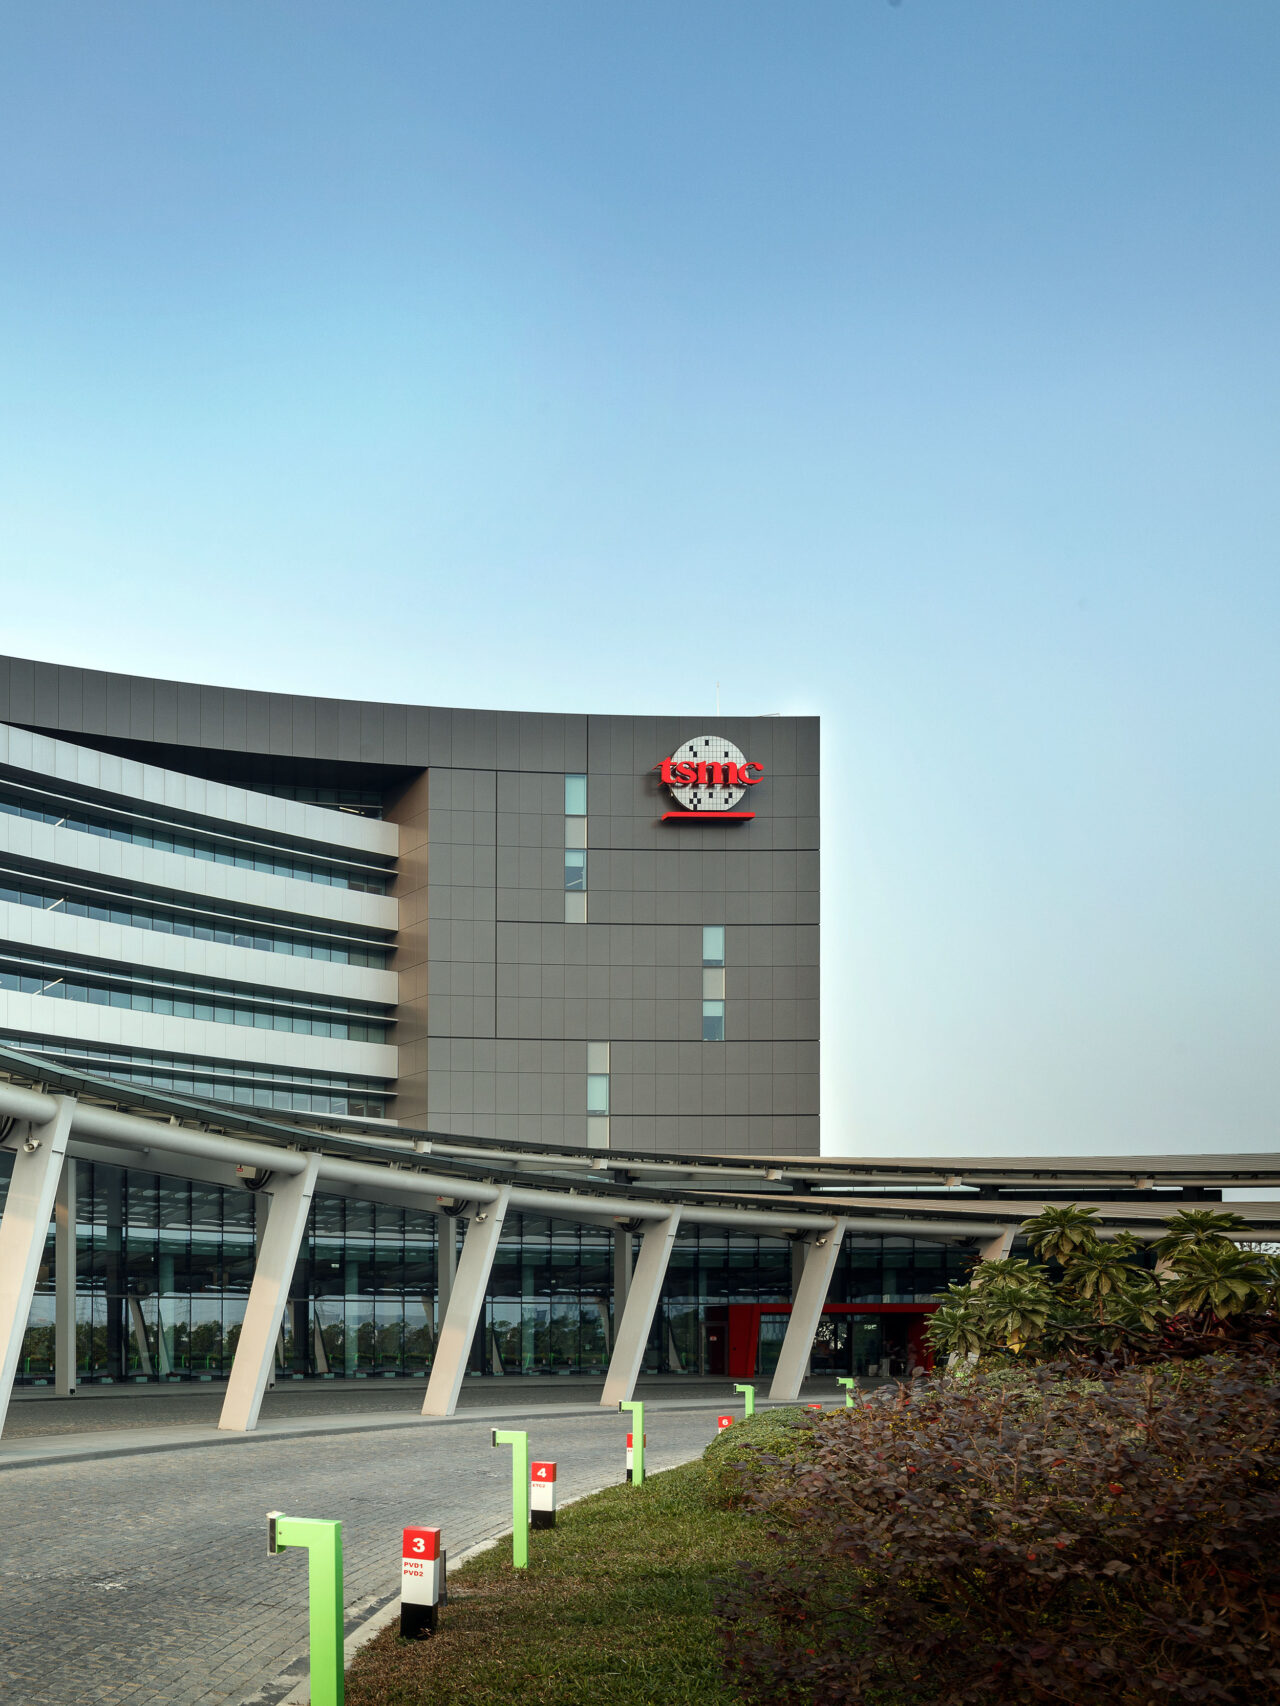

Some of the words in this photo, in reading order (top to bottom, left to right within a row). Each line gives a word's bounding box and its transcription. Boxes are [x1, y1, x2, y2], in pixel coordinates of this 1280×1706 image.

[652, 756, 764, 786] tsmc
[722, 1418, 729, 1426] 6
[536, 1467, 547, 1479] 4
[412, 1537, 426, 1553] 3
[403, 1561, 424, 1569] PVD1
[403, 1569, 424, 1577] PVD2
